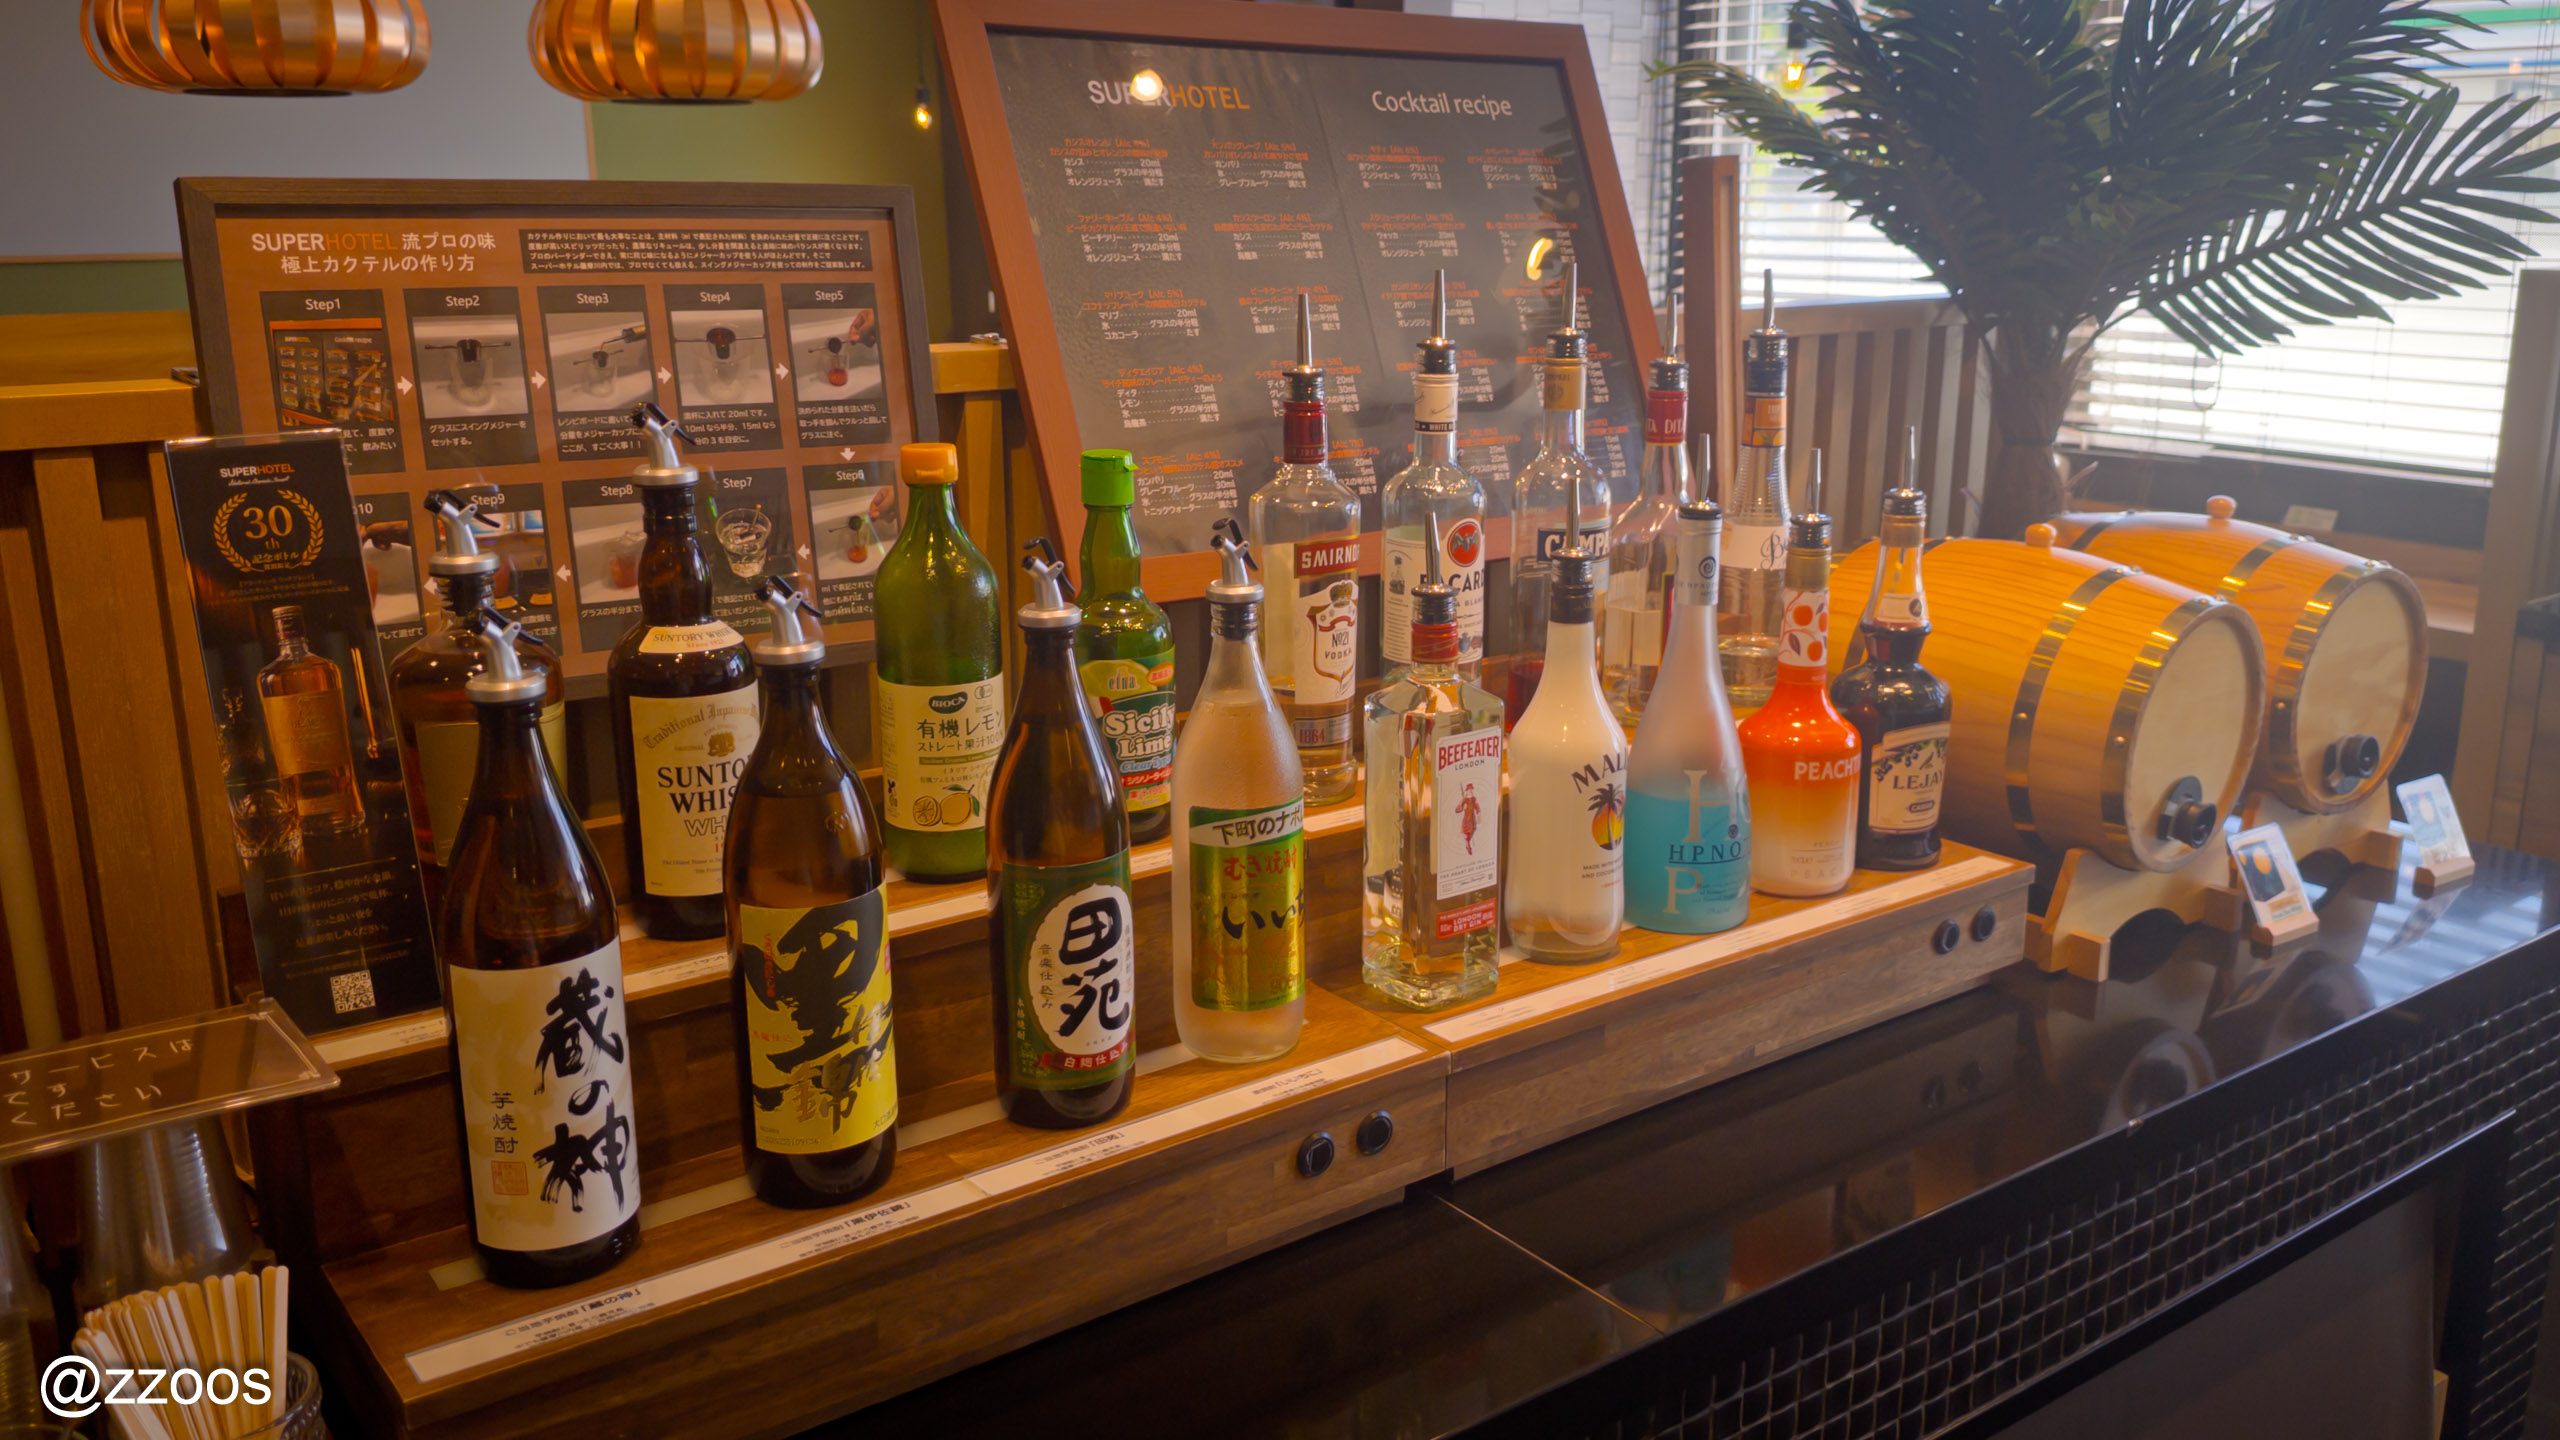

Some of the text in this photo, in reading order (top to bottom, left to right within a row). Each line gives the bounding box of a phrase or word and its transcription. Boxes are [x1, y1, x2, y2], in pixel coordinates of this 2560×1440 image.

[1372, 91, 1512, 120] Cocktail recipe
[402, 231, 497, 251] 流プロの味
[281, 254, 476, 275] 極上カクテルの作り方
[445, 294, 481, 308] Step2
[576, 292, 609, 306] Step3
[700, 290, 731, 304] Step4
[814, 288, 844, 302] Step5
[305, 298, 342, 312] Step1
[429, 420, 527, 434] グラスにスイングメジャーを
[741, 422, 762, 430] 15ml
[431, 438, 473, 447] セットする。
[220, 464, 295, 478] SUPERHOTEL
[1213, 469, 1234, 479] 20ml
[722, 476, 753, 490] Step7
[600, 485, 634, 498] Step8
[470, 494, 505, 507] Step9
[243, 505, 293, 539] 30
[653, 632, 704, 643] SUNTORY
[931, 696, 966, 708] BIOCA
[642, 707, 705, 749] Traditional
[1104, 705, 1175, 737] Sicily
[917, 718, 960, 739] 有機
[1300, 727, 1325, 743] 1864
[1119, 735, 1172, 759] Lime
[1438, 735, 1500, 771] BEEFEATER
[1455, 759, 1485, 771] LONDON
[1582, 871, 1595, 879] AND
[1453, 912, 1482, 927] LONDON
[1453, 919, 1482, 933] DRY GIN
[1056, 896, 1130, 1037] 田苑
[1039, 944, 1054, 1009] 音楽仕込み
[491, 1092, 519, 1154] 芋焼酎
